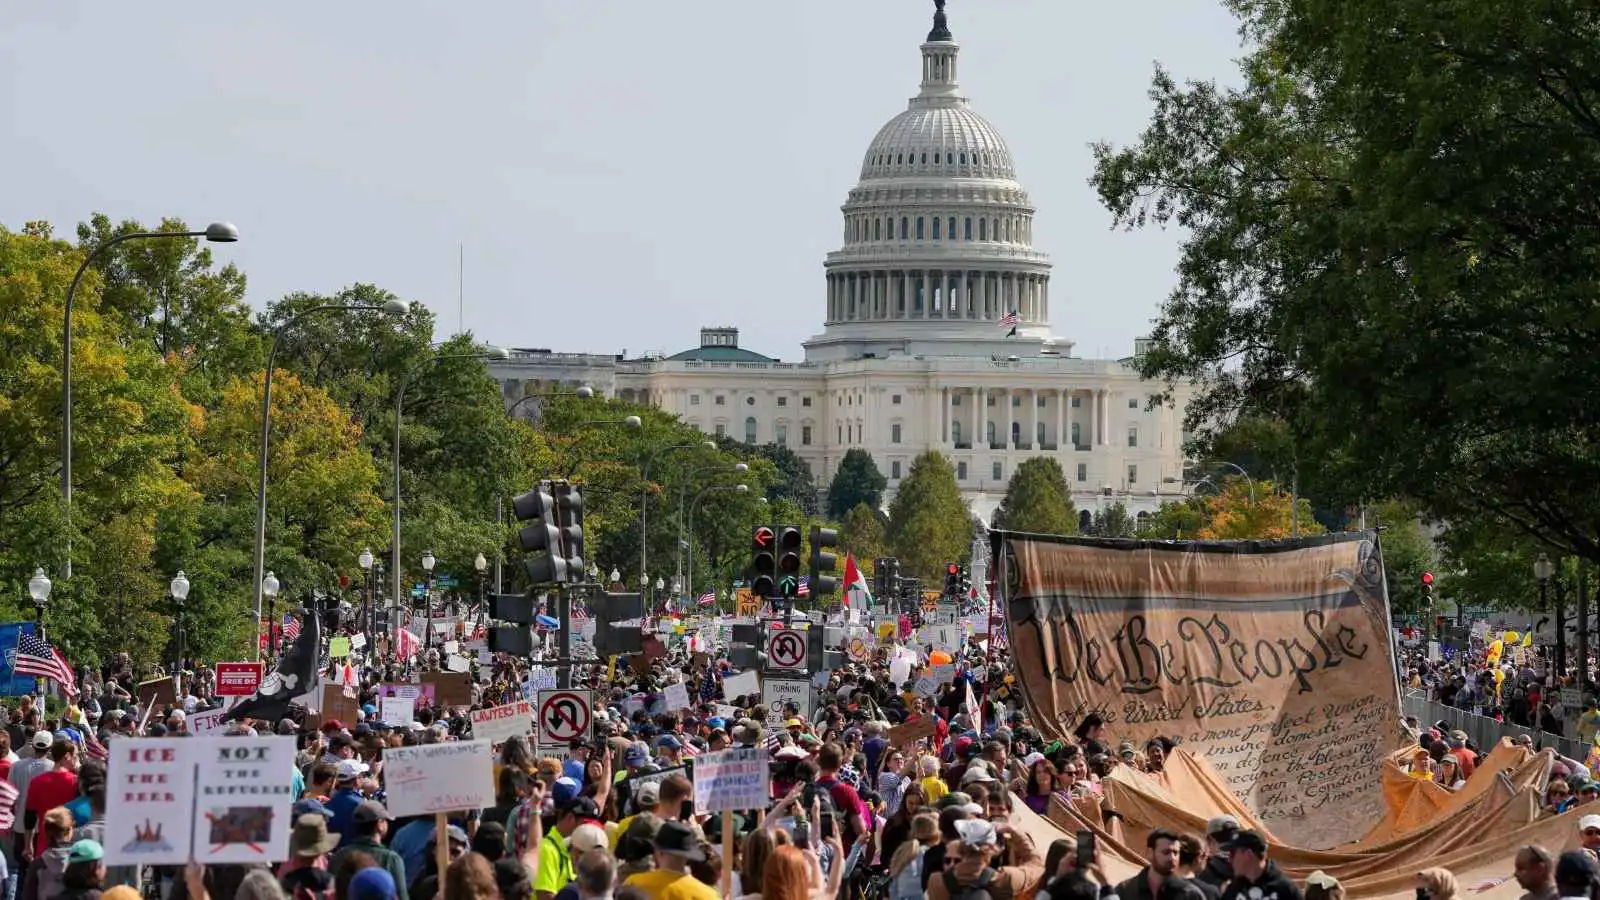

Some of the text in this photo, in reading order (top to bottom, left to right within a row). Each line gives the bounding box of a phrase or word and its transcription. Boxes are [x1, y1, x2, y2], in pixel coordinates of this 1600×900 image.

[1018, 605, 1113, 687] We
[1177, 609, 1369, 695] People
[772, 684, 801, 694] TURNING
[1123, 696, 1191, 724] United
[1200, 728, 1241, 742] more
[1241, 703, 1316, 742] perfect
[1273, 718, 1344, 746] domestic
[127, 747, 176, 763] ICE
[216, 746, 271, 761] NOT
[1286, 756, 1309, 773] the
[124, 773, 168, 784] THE
[223, 769, 261, 779] THE
[1260, 780, 1288, 794] our
[1264, 791, 1298, 806] this
